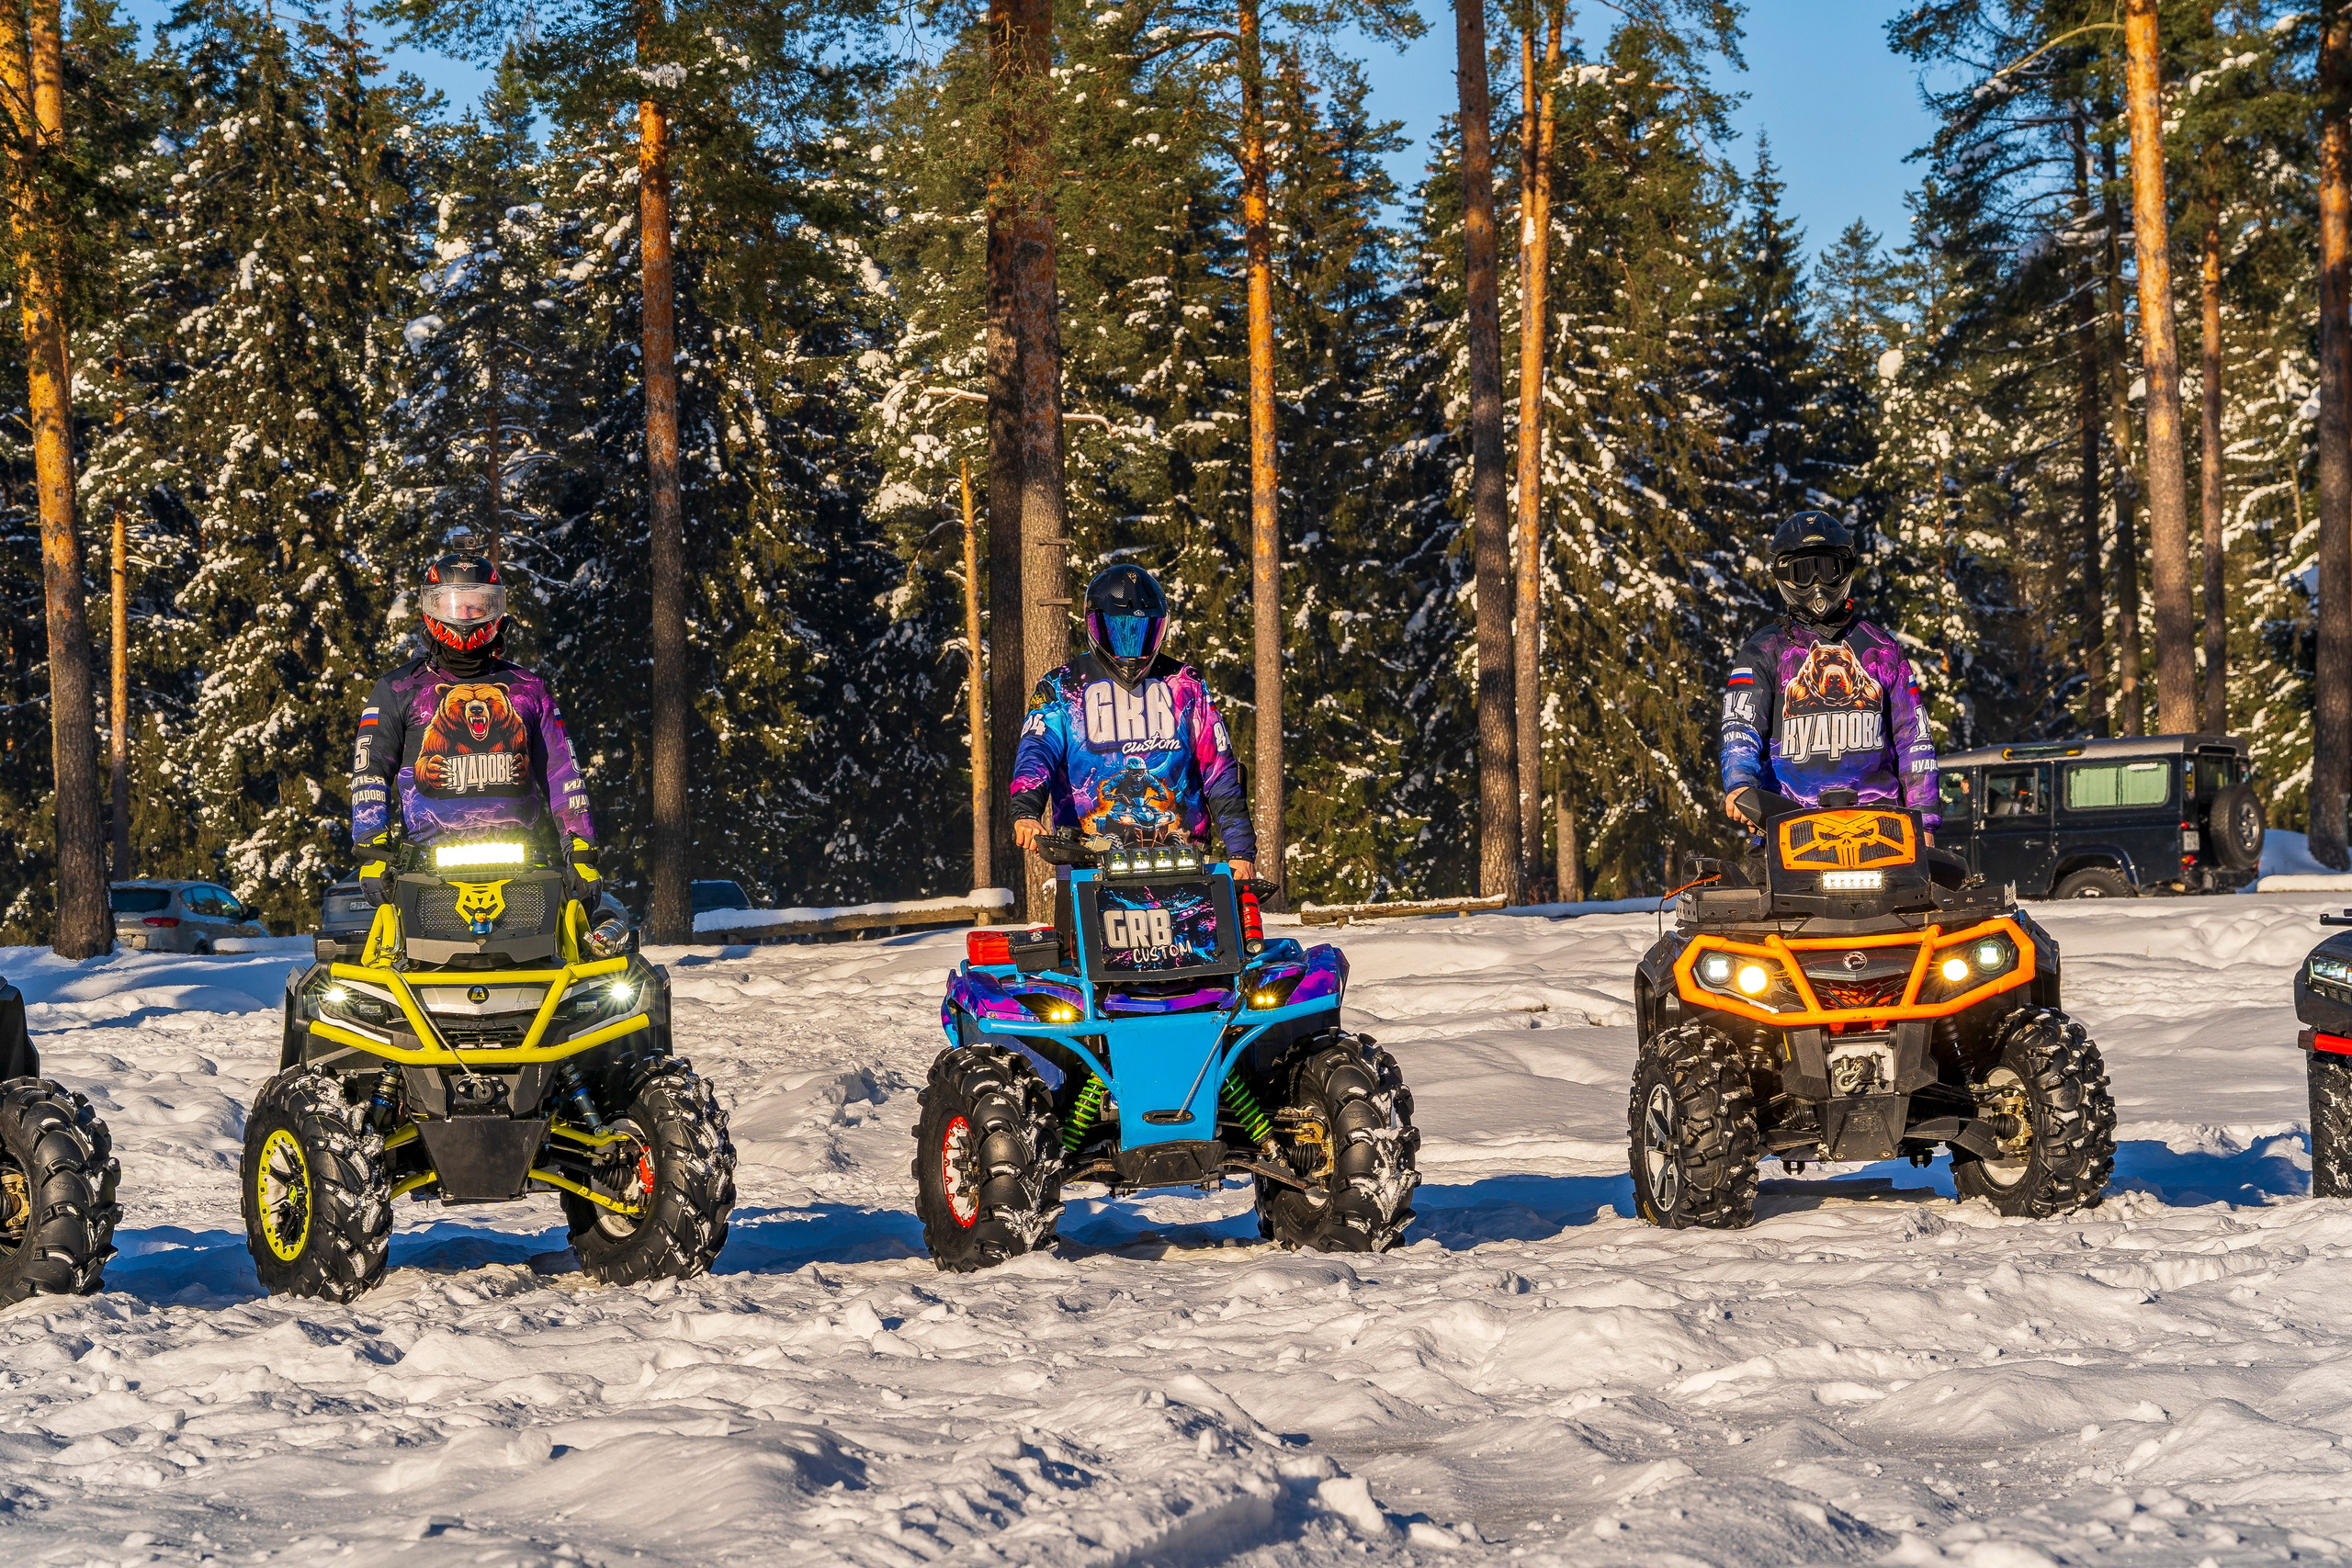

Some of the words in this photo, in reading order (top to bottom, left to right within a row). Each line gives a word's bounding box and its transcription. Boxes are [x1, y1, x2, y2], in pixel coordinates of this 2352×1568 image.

[1723, 691, 1756, 724] 14
[1914, 705, 1933, 742] 1
[1122, 731, 1181, 754] custom
[1213, 721, 1232, 752] 8
[354, 735, 372, 773] 5
[1103, 908, 1173, 949] GRB
[1133, 940, 1193, 964] CUSTOM
